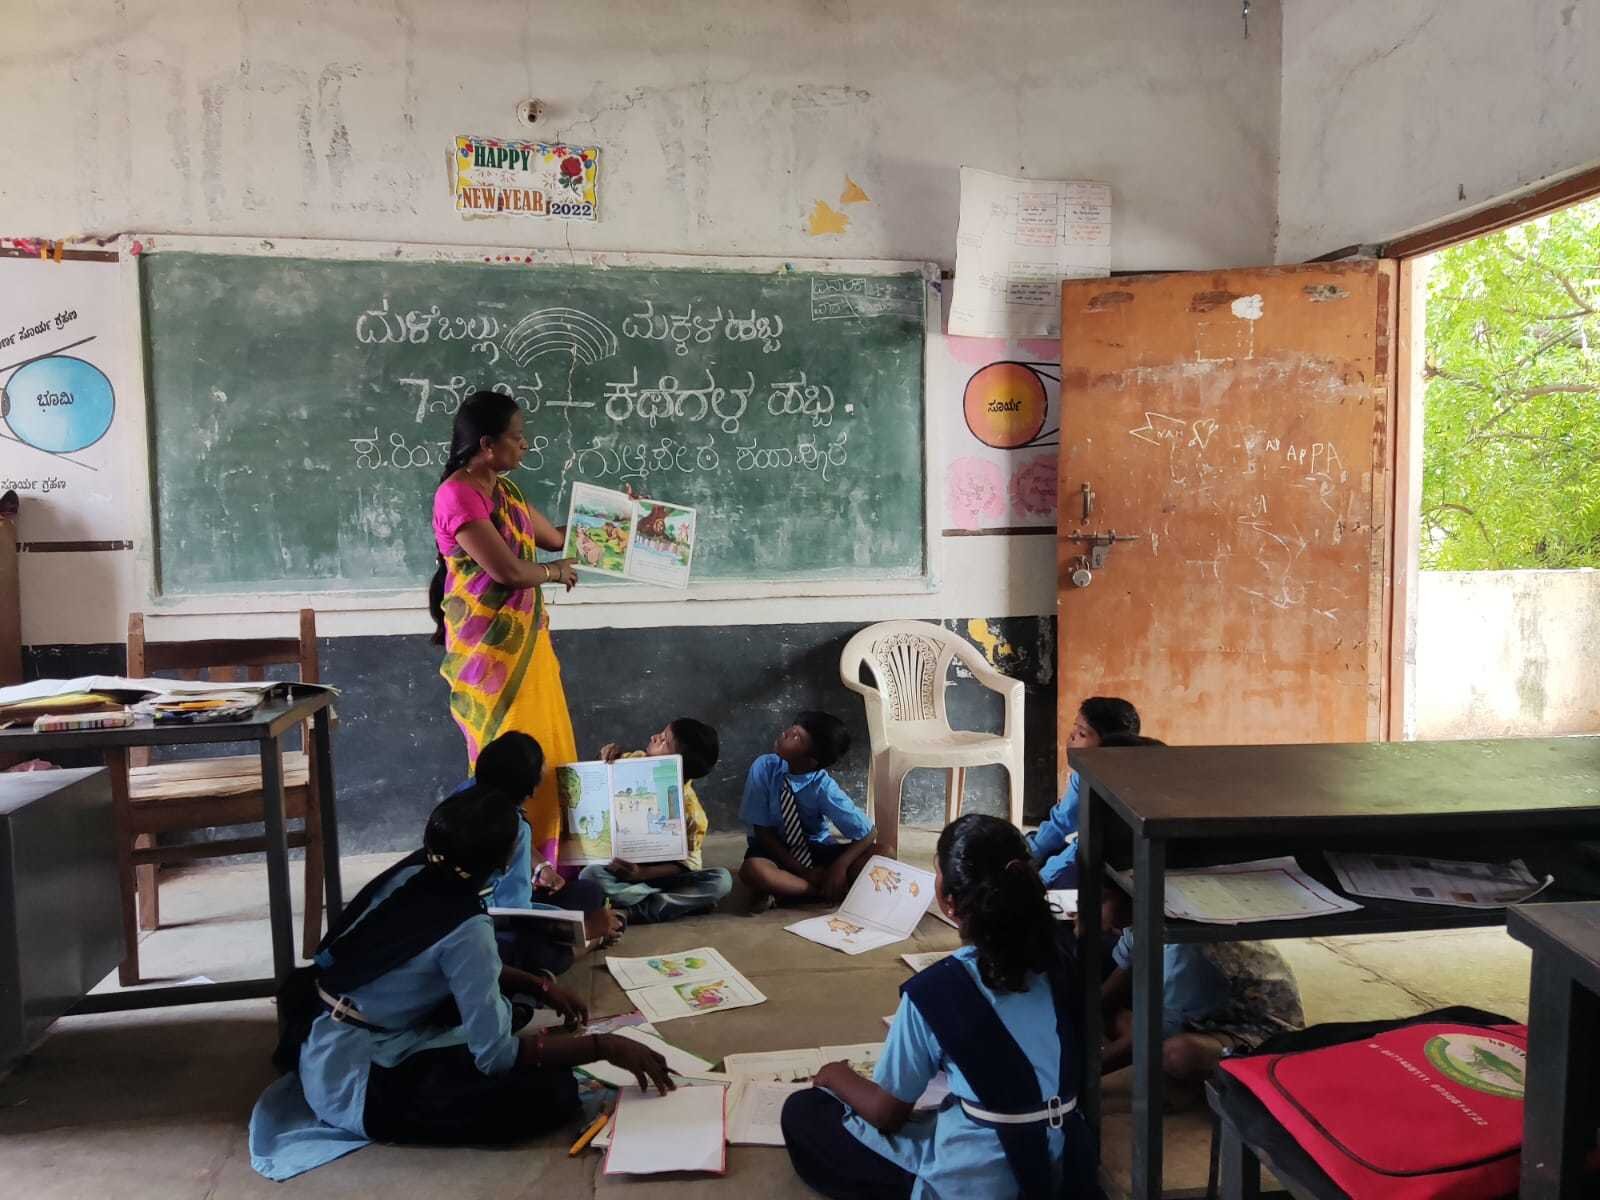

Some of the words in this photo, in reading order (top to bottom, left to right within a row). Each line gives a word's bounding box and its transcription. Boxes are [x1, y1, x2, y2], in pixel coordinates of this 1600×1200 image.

[473, 145, 531, 172] HAPPY
[462, 187, 497, 209] NEW
[502, 188, 544, 212] YEAR
[551, 202, 592, 216] 2022
[19, 320, 51, 340] ಸೂರ್ಯ
[54, 310, 78, 330] ಗ್ರಹಣ
[356, 299, 501, 365] ಮಳೆಬಿಲ್ಲು
[37, 391, 74, 412] ಭೂಮಿ
